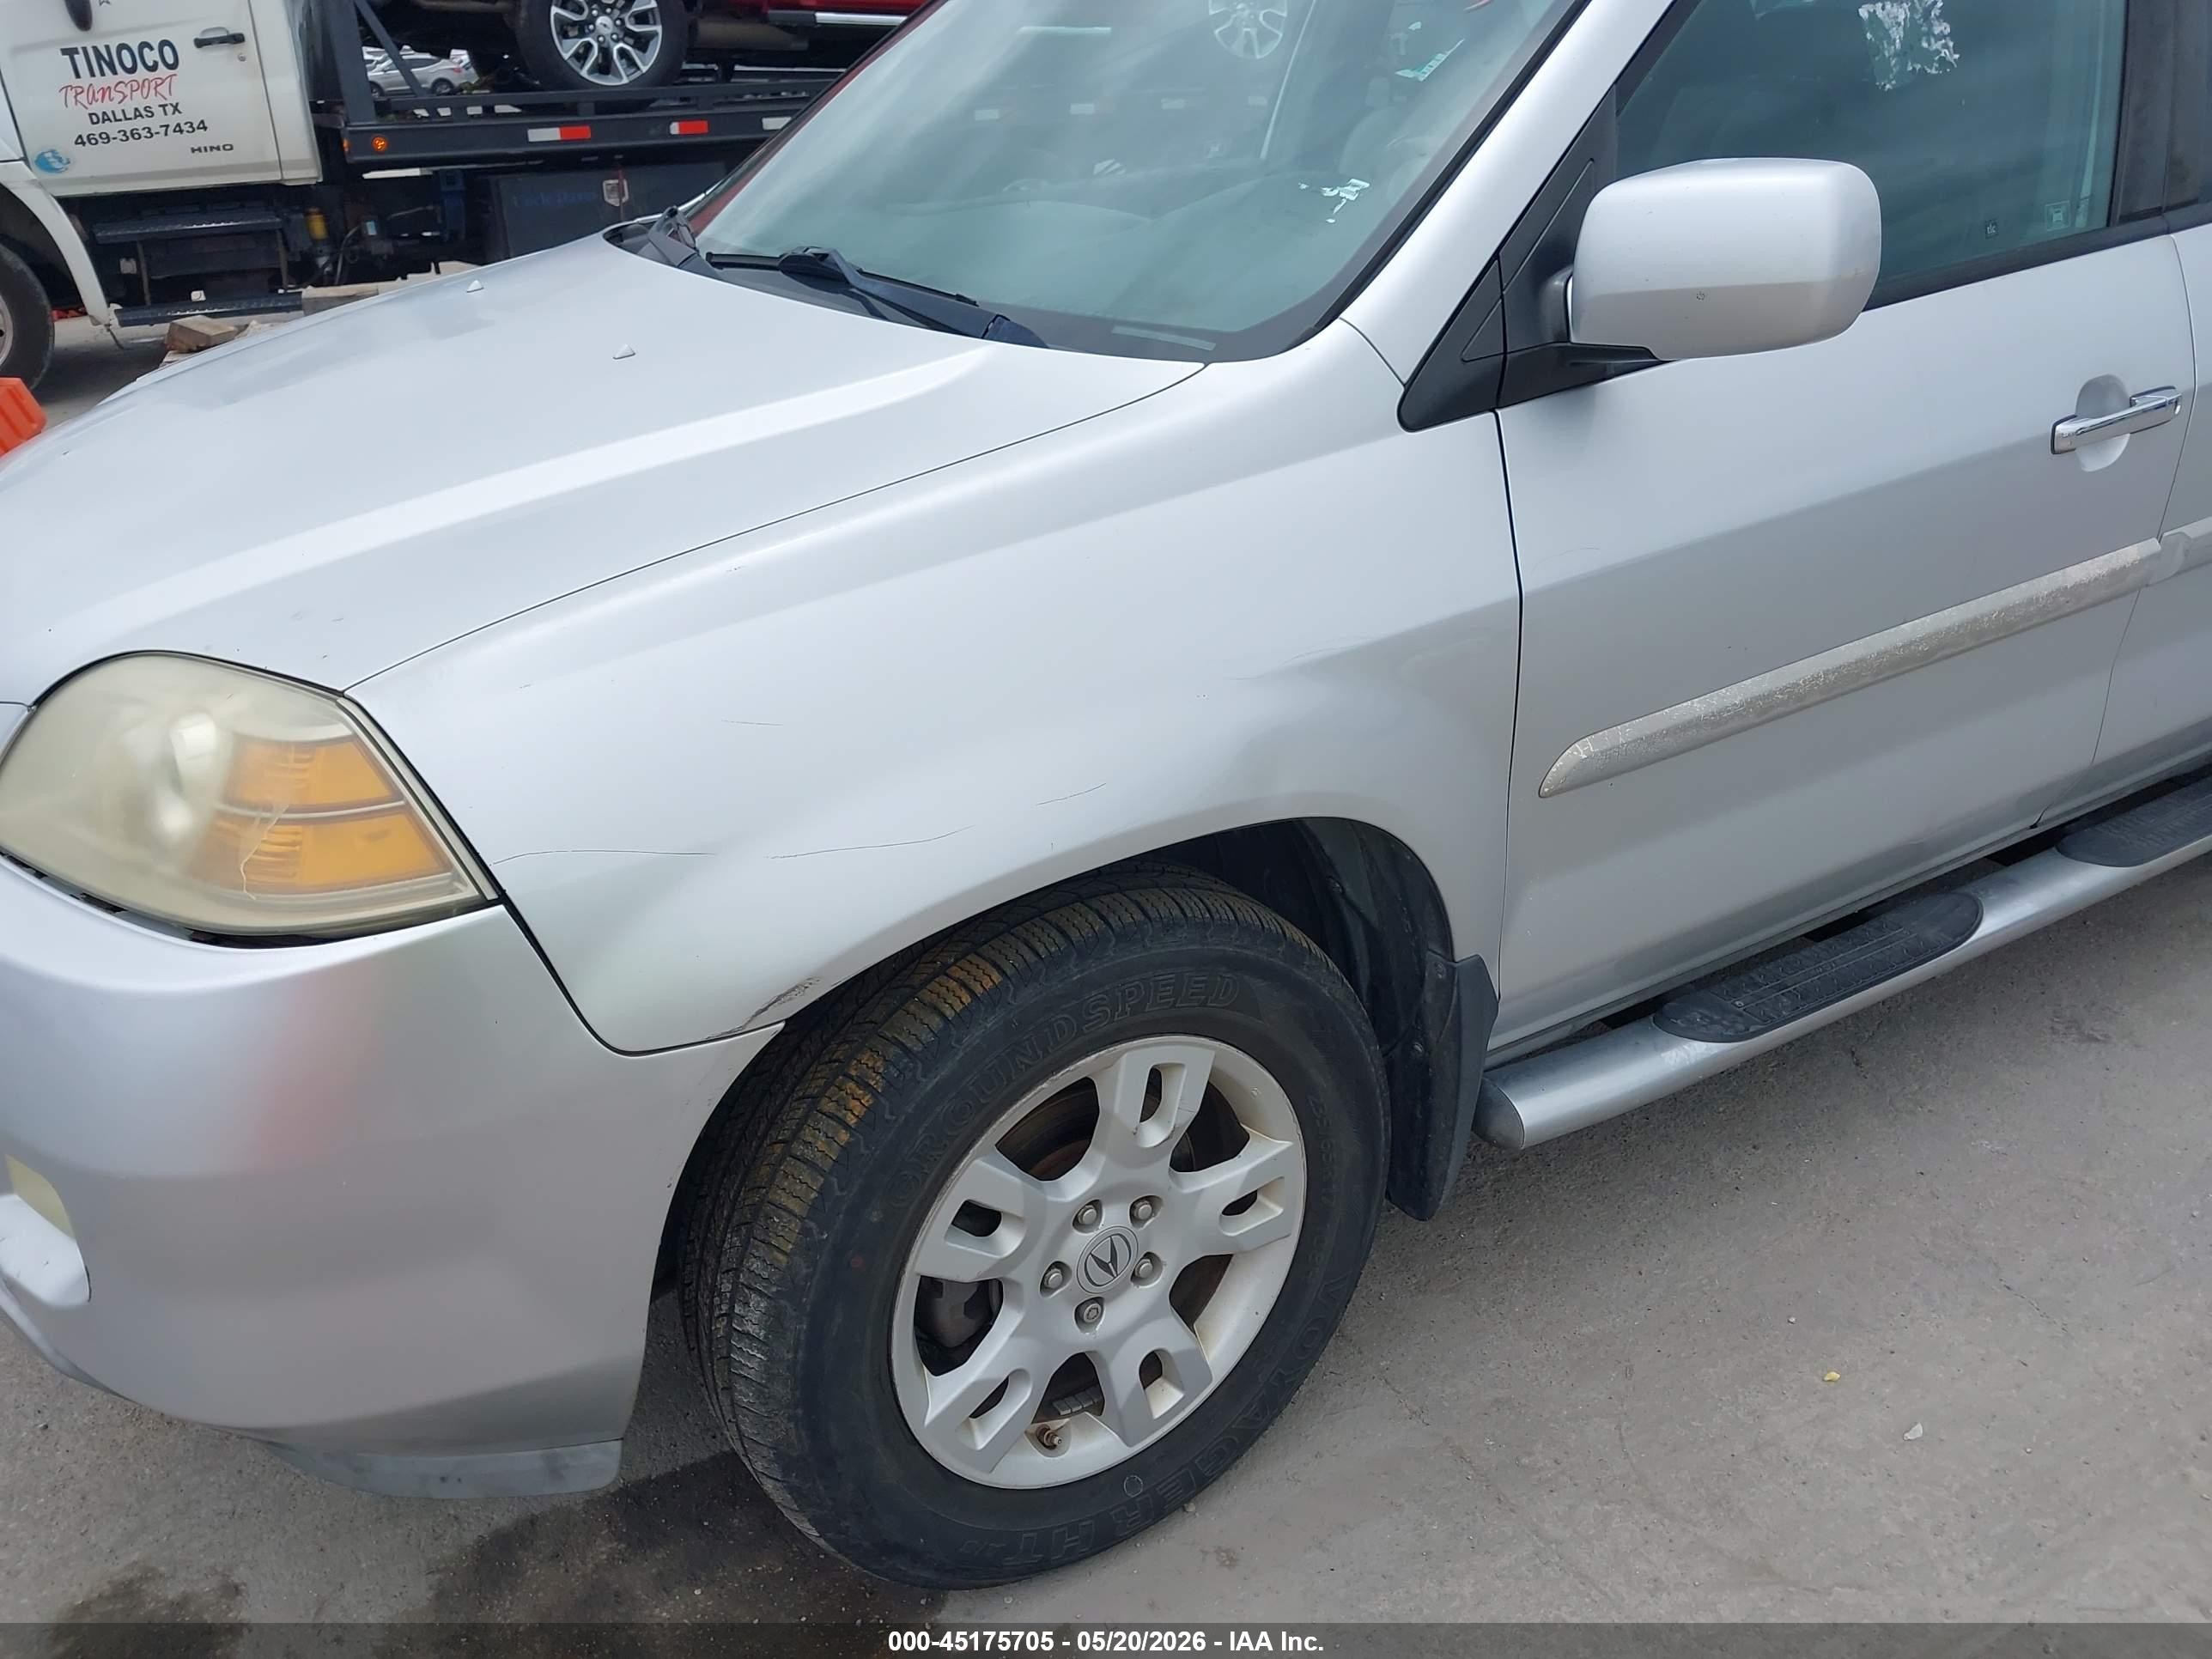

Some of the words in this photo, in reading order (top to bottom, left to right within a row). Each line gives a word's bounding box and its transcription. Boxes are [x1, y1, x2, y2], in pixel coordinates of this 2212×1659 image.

[60, 40, 179, 79] TINOCO
[88, 106, 155, 125] DALLAS
[158, 102, 183, 116] TX
[74, 119, 208, 147] 469-363-7434
[191, 143, 234, 154] HINO
